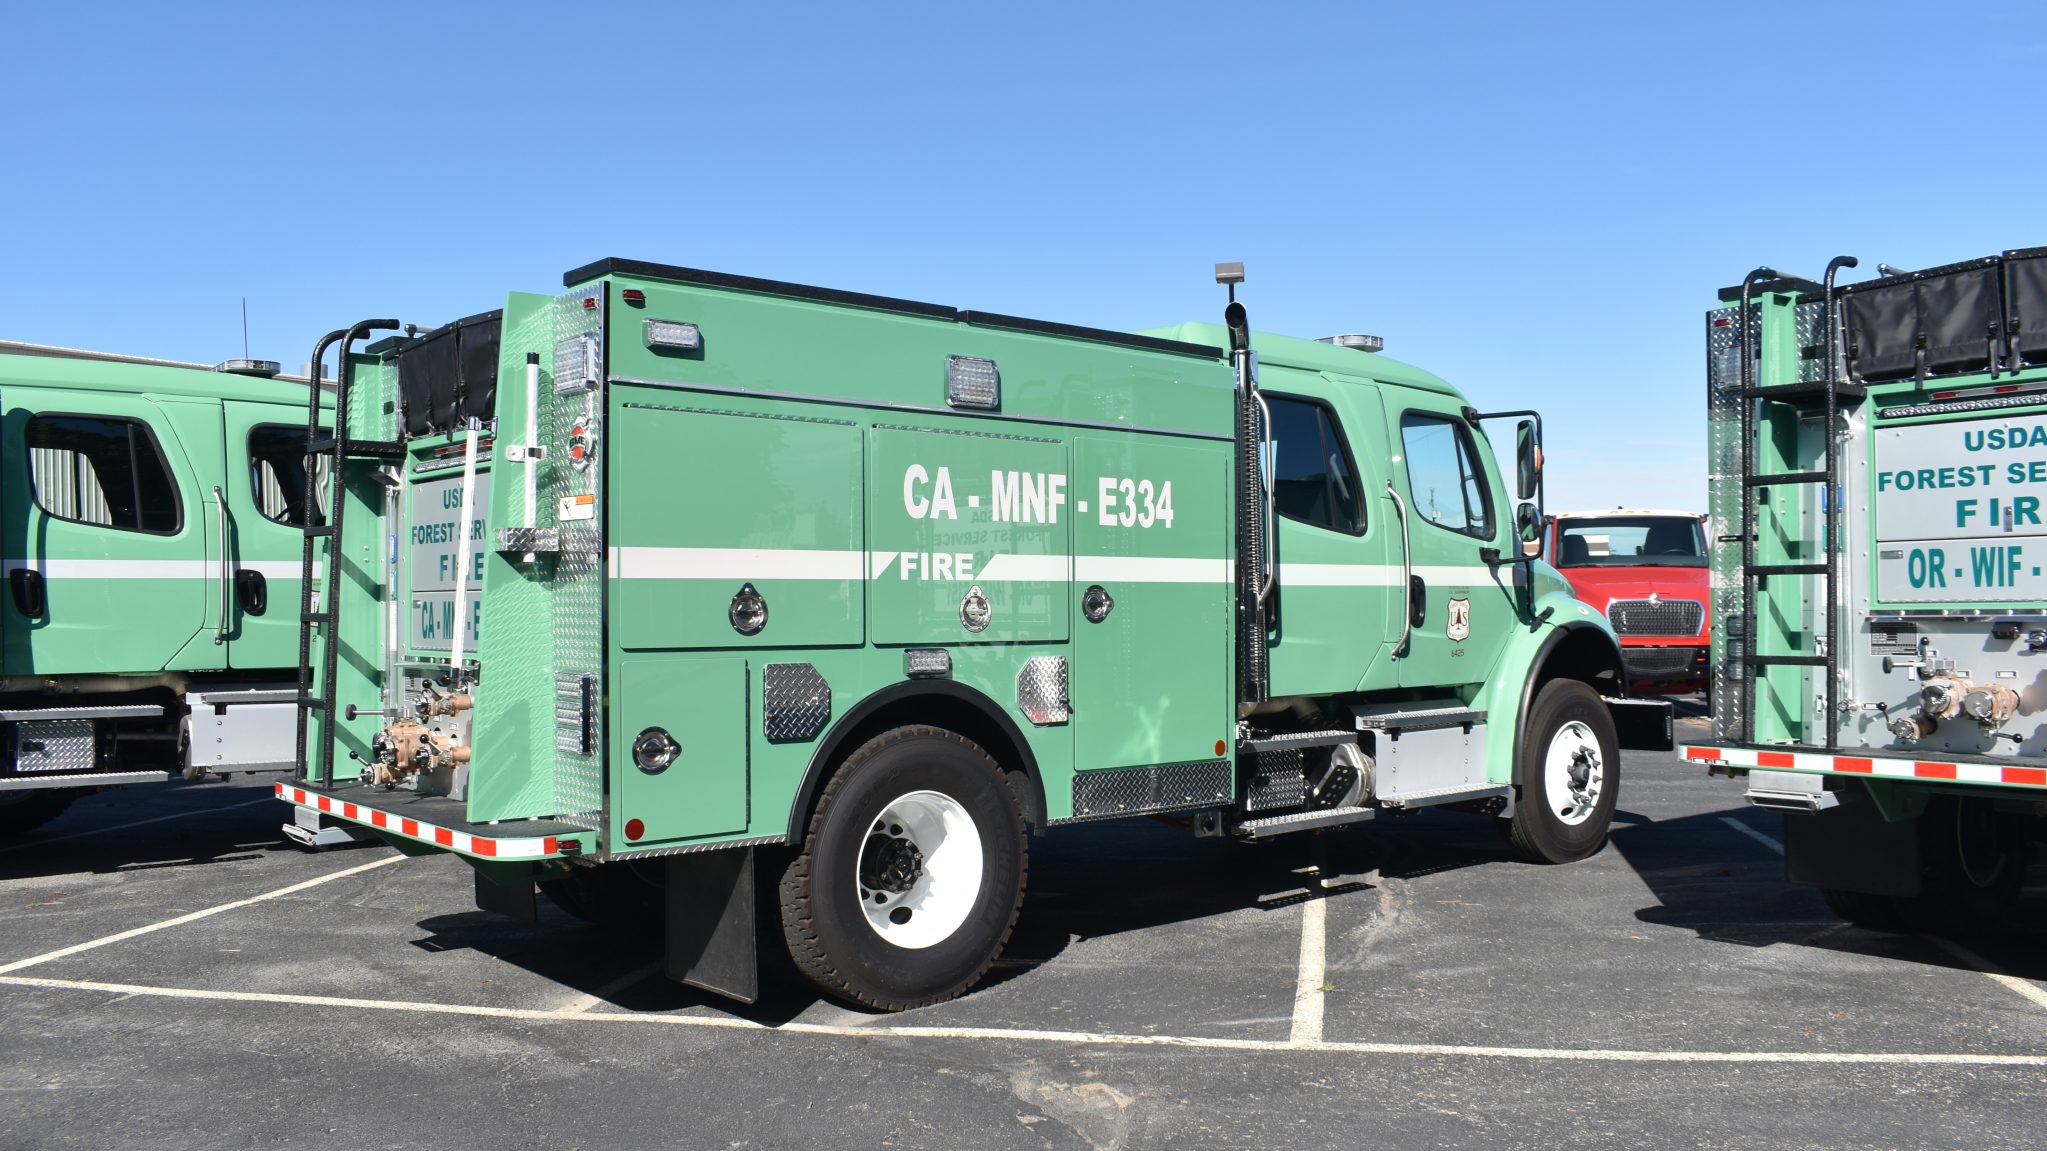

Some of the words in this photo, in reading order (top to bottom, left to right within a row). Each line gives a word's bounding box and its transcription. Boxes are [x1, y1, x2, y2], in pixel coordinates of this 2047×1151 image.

[1964, 425, 2047, 451] USDA
[1878, 464, 1996, 492] FOREST
[903, 463, 957, 520] CA
[991, 470, 1067, 524] MNF
[1098, 477, 1174, 529] E334
[411, 522, 455, 544] FOREST
[440, 552, 484, 582] FIE
[900, 552, 974, 581] FIRE
[1908, 548, 1947, 589] OR
[1970, 545, 2022, 588] WIF
[421, 601, 434, 640] CA
